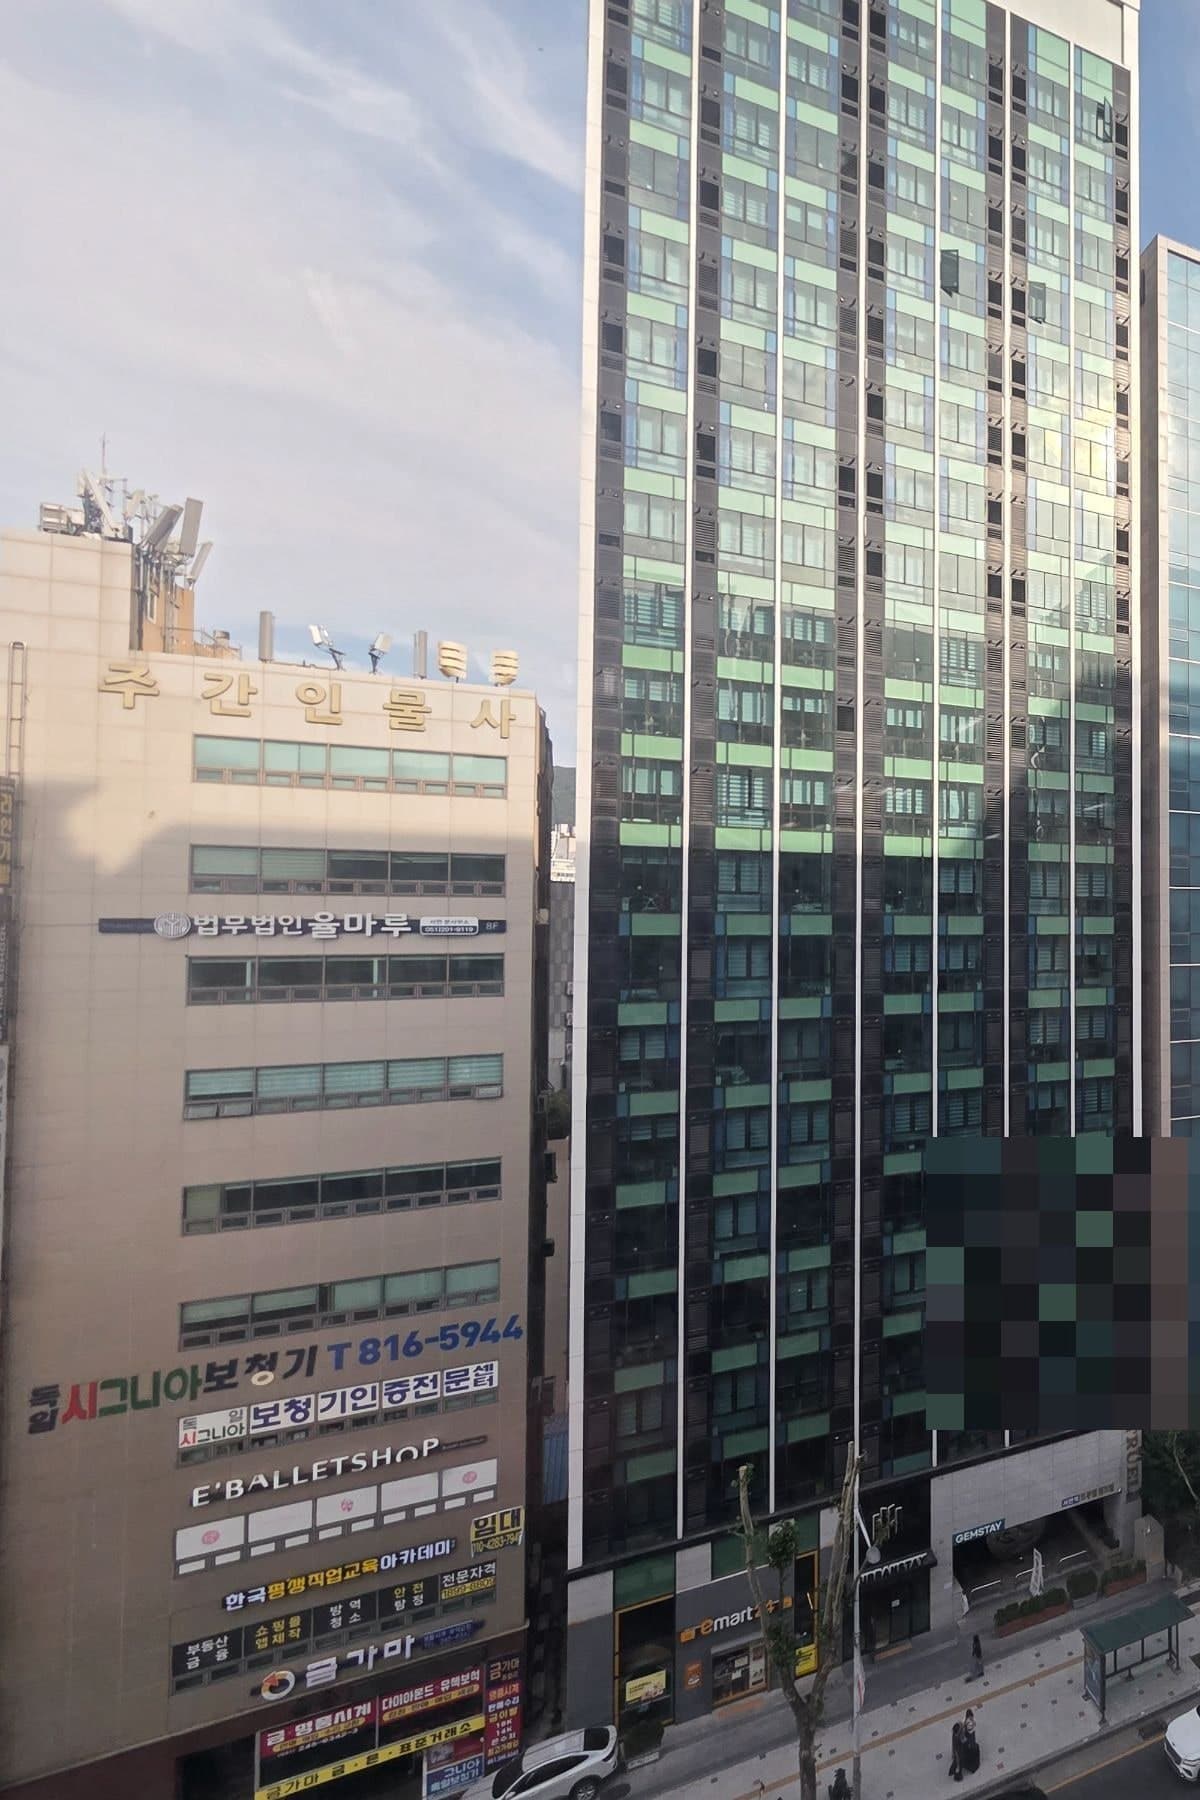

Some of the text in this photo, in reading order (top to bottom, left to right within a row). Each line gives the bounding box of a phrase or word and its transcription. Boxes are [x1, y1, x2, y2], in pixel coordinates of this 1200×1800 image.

[99, 662, 516, 738] 주간인물사
[193, 913, 303, 936] 법무법인
[328, 1342, 352, 1370] T
[358, 1314, 524, 1366] 816-5944
[181, 1423, 245, 1446] 시그니아
[474, 1508, 521, 1538] 임대
[955, 1521, 1002, 1544] GEMSTAY
[442, 1562, 496, 1587] 전문자격
[394, 1582, 424, 1599] 안전
[394, 1593, 424, 1611] 탐정
[330, 1599, 361, 1617] 방역
[330, 1612, 361, 1629] 청소
[186, 1635, 229, 1656] 부동산
[305, 1634, 415, 1689] 금가마
[267, 1773, 319, 1800] 금가마
[400, 1722, 471, 1751] 표준거래소
